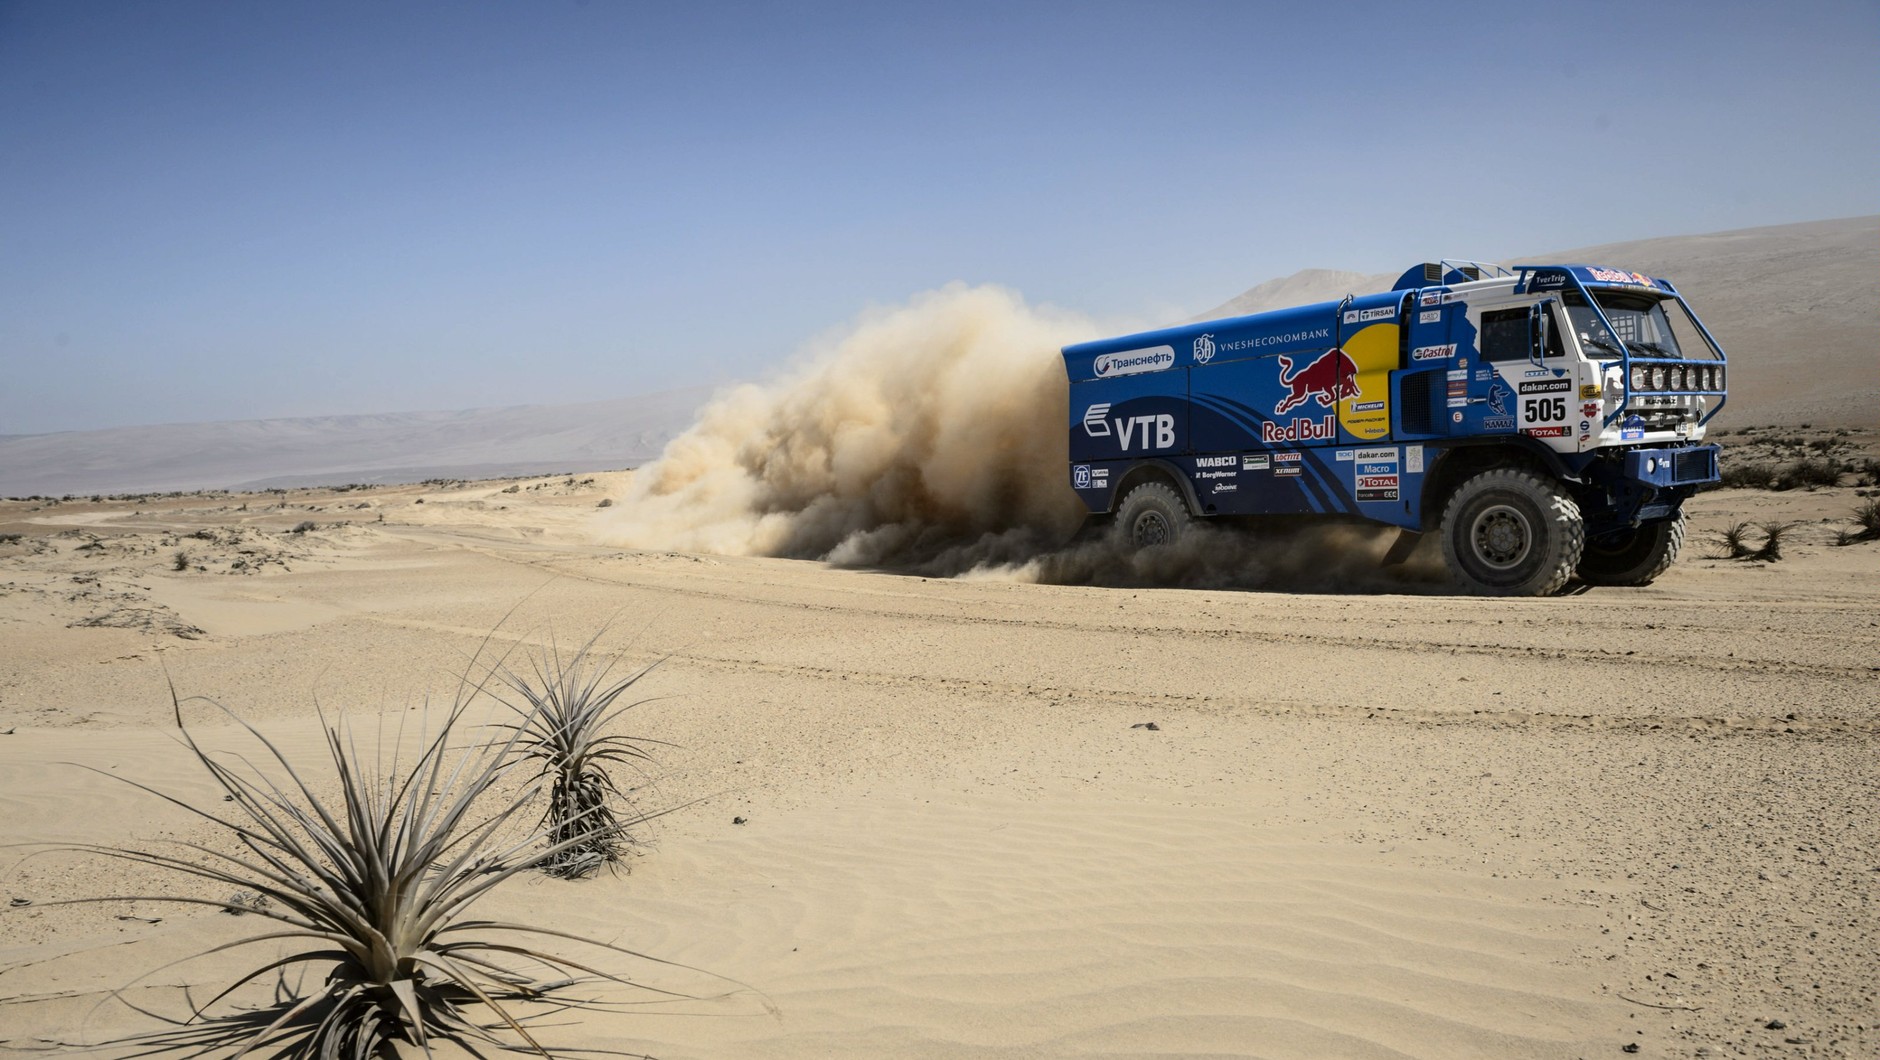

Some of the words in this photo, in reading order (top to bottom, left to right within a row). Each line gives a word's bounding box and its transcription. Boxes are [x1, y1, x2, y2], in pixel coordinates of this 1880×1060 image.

[1536, 274, 1566, 283] TverTrip
[1220, 328, 1329, 352] VNESHECONOMBANK
[1422, 345, 1454, 359] Castrol
[1111, 352, 1172, 370] Транснефть
[1521, 382, 1569, 392] dakar.com
[1356, 402, 1384, 411] MICHELIN
[1525, 397, 1566, 423] 505
[1262, 418, 1298, 443] Red
[1299, 414, 1336, 441] Bull
[1484, 419, 1514, 430] KAMAZ
[1115, 413, 1175, 451] VTB
[1529, 428, 1561, 437] TOTAL
[1275, 453, 1301, 461] LOCTITE
[1358, 451, 1395, 459] dakar.com
[1196, 456, 1237, 468] WABCO
[1363, 464, 1390, 473] Macro
[1076, 470, 1088, 483] ZF
[1202, 471, 1237, 479] BorgWarner
[1366, 478, 1397, 486] TOTAL
